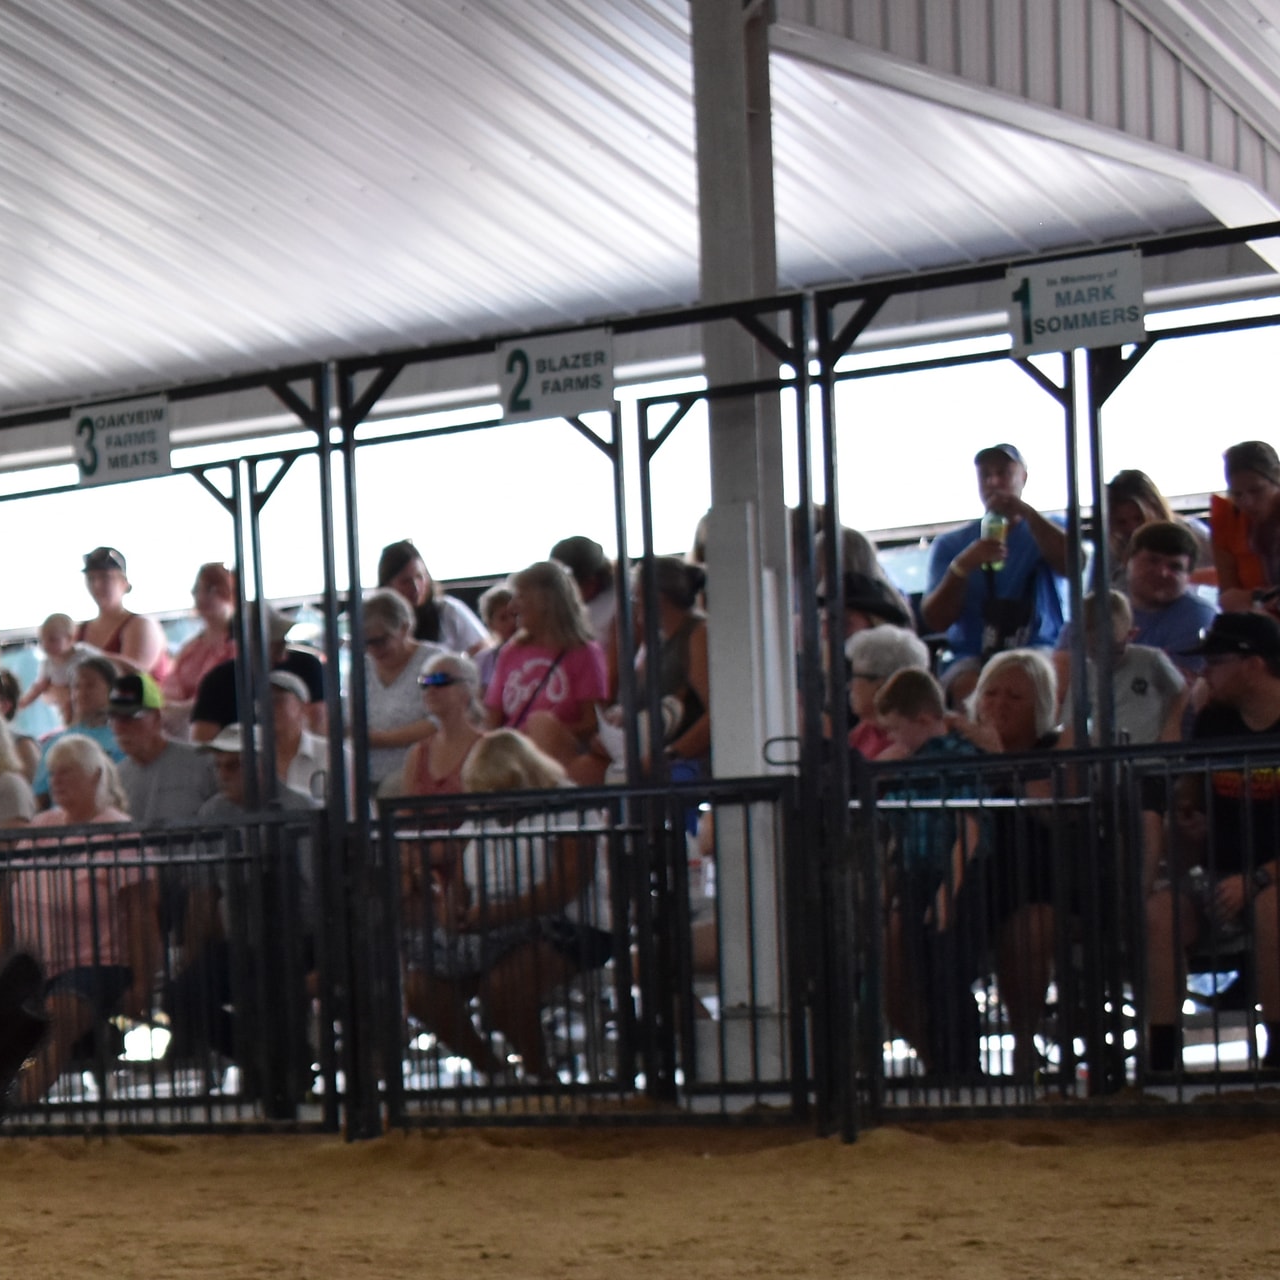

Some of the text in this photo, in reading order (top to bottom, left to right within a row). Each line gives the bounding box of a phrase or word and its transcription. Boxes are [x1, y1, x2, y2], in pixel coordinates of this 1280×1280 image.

[1060, 272, 1104, 286] Memory
[1107, 269, 1118, 279] of
[1055, 284, 1116, 308] MARK
[1012, 277, 1033, 346] 1
[1034, 305, 1139, 334] SOMMERS
[535, 351, 606, 374] BLAZER
[506, 348, 531, 413] 2
[541, 374, 602, 395] FARMS
[76, 417, 98, 477] 3
[105, 429, 156, 450] FARMS
[107, 450, 158, 470] MEATS
